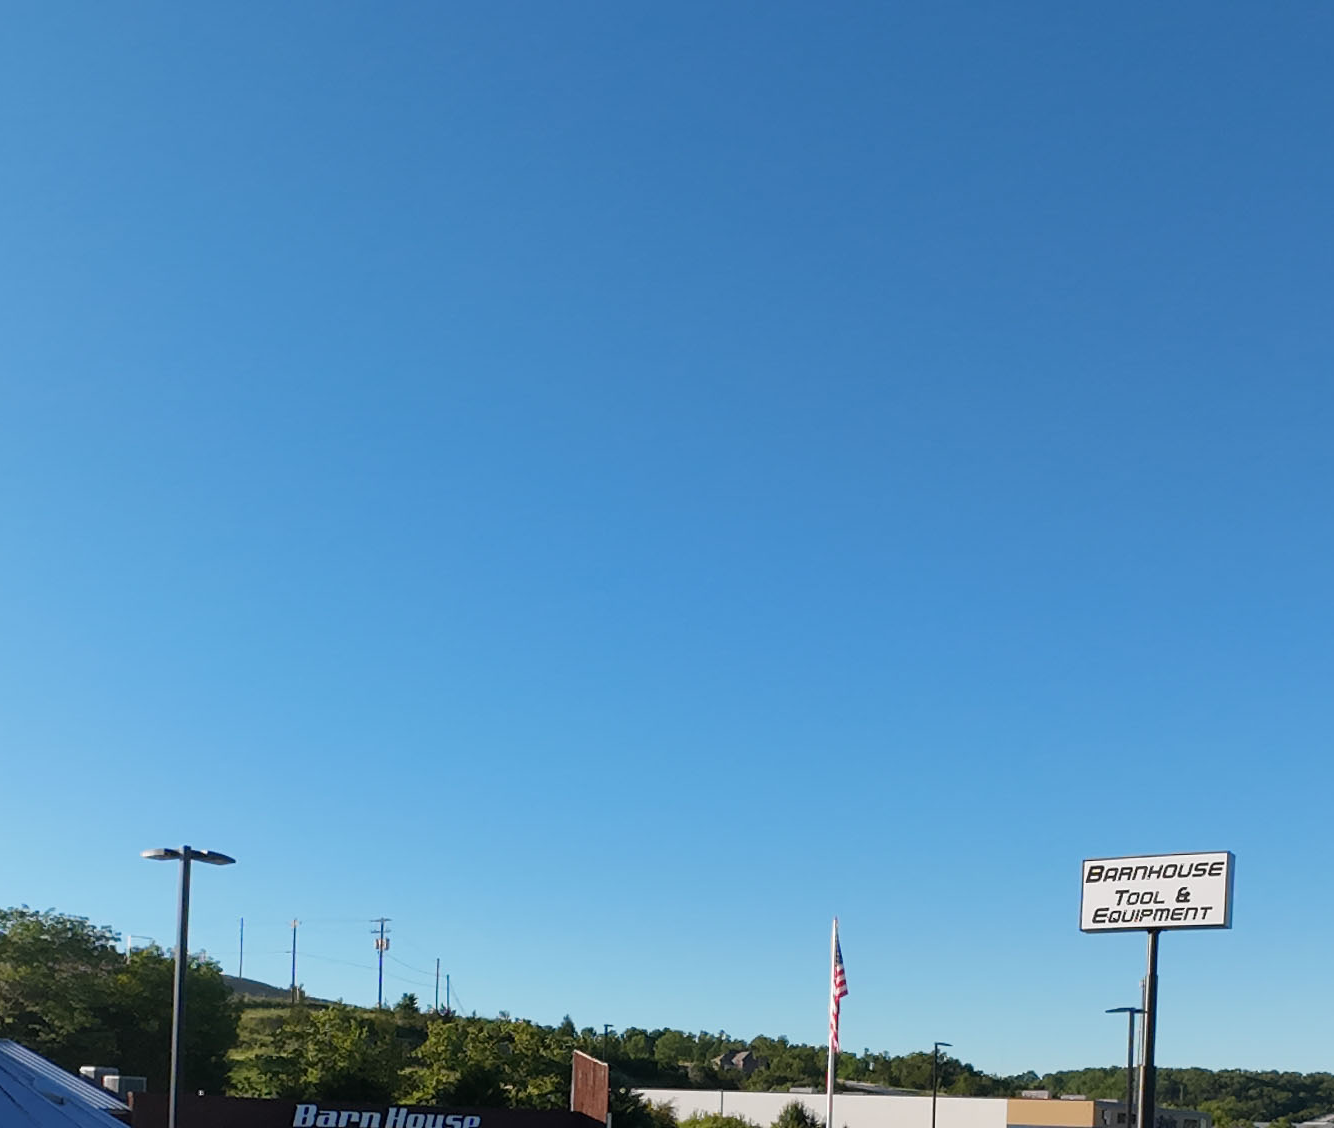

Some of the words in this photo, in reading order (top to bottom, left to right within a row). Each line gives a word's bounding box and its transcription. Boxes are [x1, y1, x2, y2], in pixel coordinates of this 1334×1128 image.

[1085, 862, 1225, 883] BARNHOUSE
[1115, 890, 1165, 906] TOOL
[1175, 886, 1191, 903] &
[1092, 906, 1213, 924] EQUIPMENT
[292, 1103, 382, 1128] Barn
